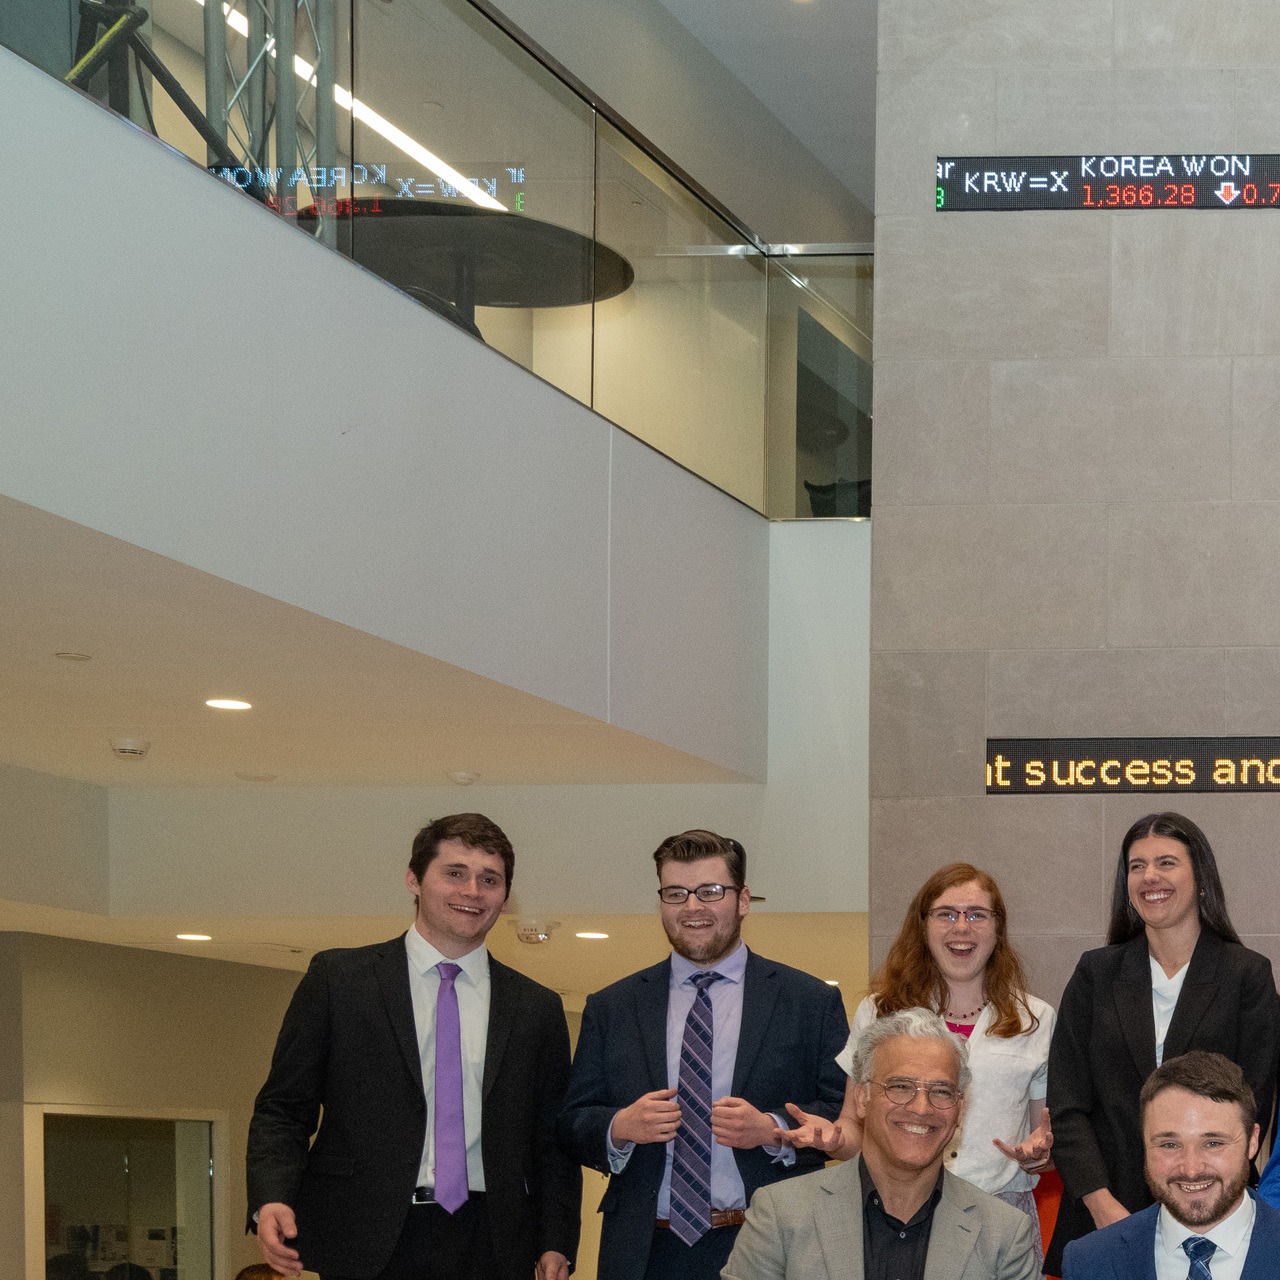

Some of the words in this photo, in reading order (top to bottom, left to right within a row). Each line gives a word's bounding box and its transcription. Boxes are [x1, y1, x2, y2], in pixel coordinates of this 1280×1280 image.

[1081, 156, 1174, 178] KOREA
[1181, 155, 1250, 177] WON
[964, 171, 1069, 193] KRW=X
[1083, 183, 1196, 207] 1,366.28
[1025, 758, 1196, 786] success
